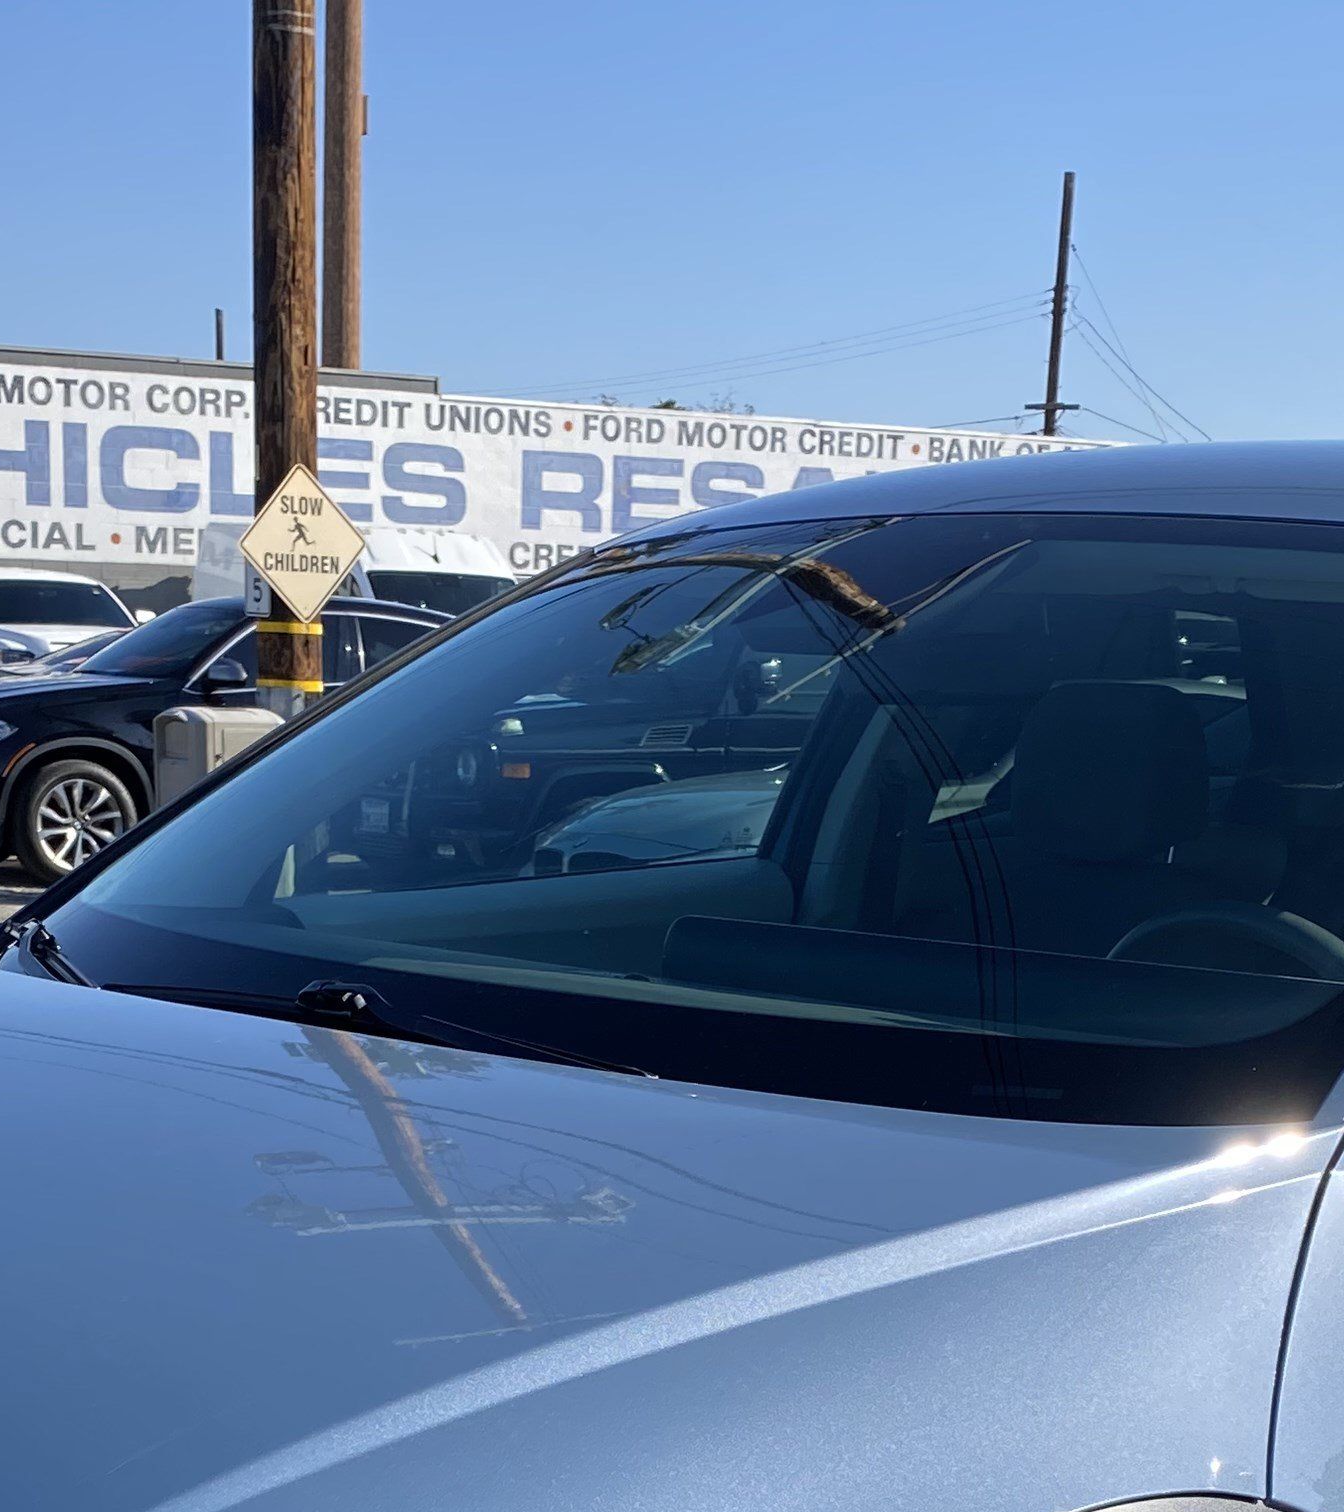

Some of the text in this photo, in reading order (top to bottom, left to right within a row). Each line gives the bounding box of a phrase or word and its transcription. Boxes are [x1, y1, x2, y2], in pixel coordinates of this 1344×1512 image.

[146, 384, 250, 419] CORP.
[316, 395, 411, 429] REDIT
[424, 402, 553, 438] UNIONS
[582, 414, 666, 444] FORD
[676, 421, 787, 454] MOTOR
[798, 429, 905, 460] CREDIT
[927, 437, 1006, 463] BANK
[280, 495, 324, 516] SLOW
[135, 525, 205, 555] ME
[509, 542, 594, 570] CRE
[263, 551, 340, 575] CHILDREN
[252, 577, 263, 604] 5
